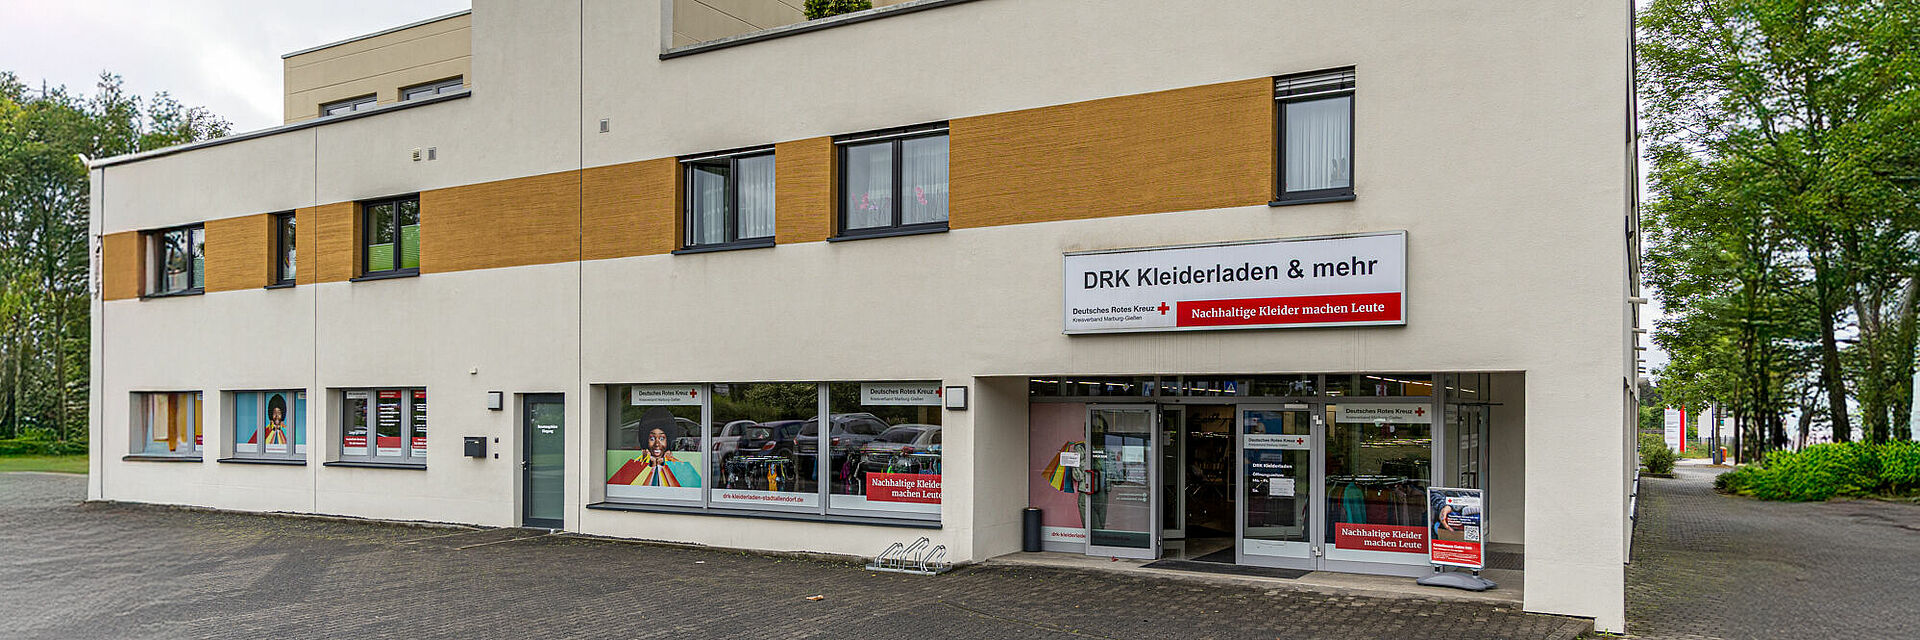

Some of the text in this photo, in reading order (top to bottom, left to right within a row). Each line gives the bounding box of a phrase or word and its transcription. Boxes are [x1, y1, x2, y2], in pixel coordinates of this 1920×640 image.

[1084, 256, 1378, 290] DRK Kleiderladen & mehr
[1072, 305, 1155, 315] Deutsches Rotes Kreuz
[1191, 302, 1385, 320] Nachhaltige Kleider machen Leute
[871, 477, 916, 490] Nachhaltige
[891, 489, 921, 498] machen
[1341, 527, 1423, 540] Nachhaltige Kleider
[1363, 539, 1397, 547] machen
[1398, 540, 1422, 549] Leute
